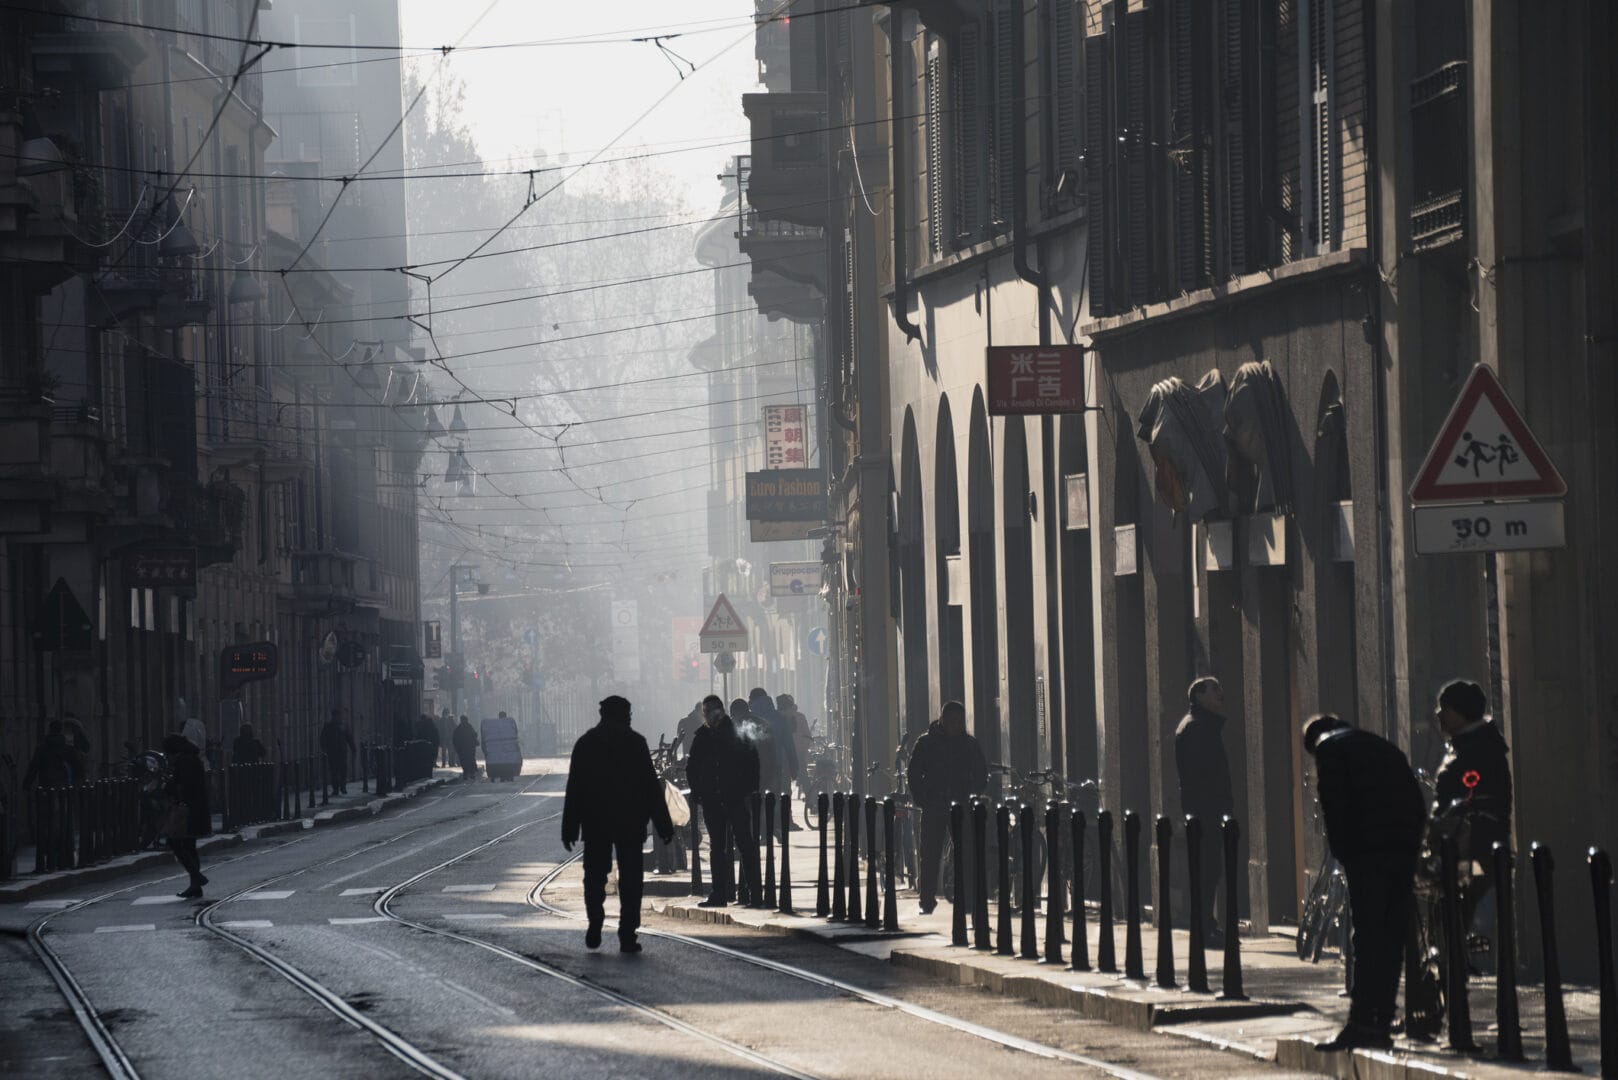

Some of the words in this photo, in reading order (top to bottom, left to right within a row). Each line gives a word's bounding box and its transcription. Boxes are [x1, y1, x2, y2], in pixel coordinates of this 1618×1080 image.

[1011, 375, 1062, 398] 广告
[750, 478, 776, 497] Euro
[778, 477, 821, 497] Fashion
[1505, 519, 1528, 536] m
[711, 639, 726, 650] 50
[728, 641, 738, 649] m
